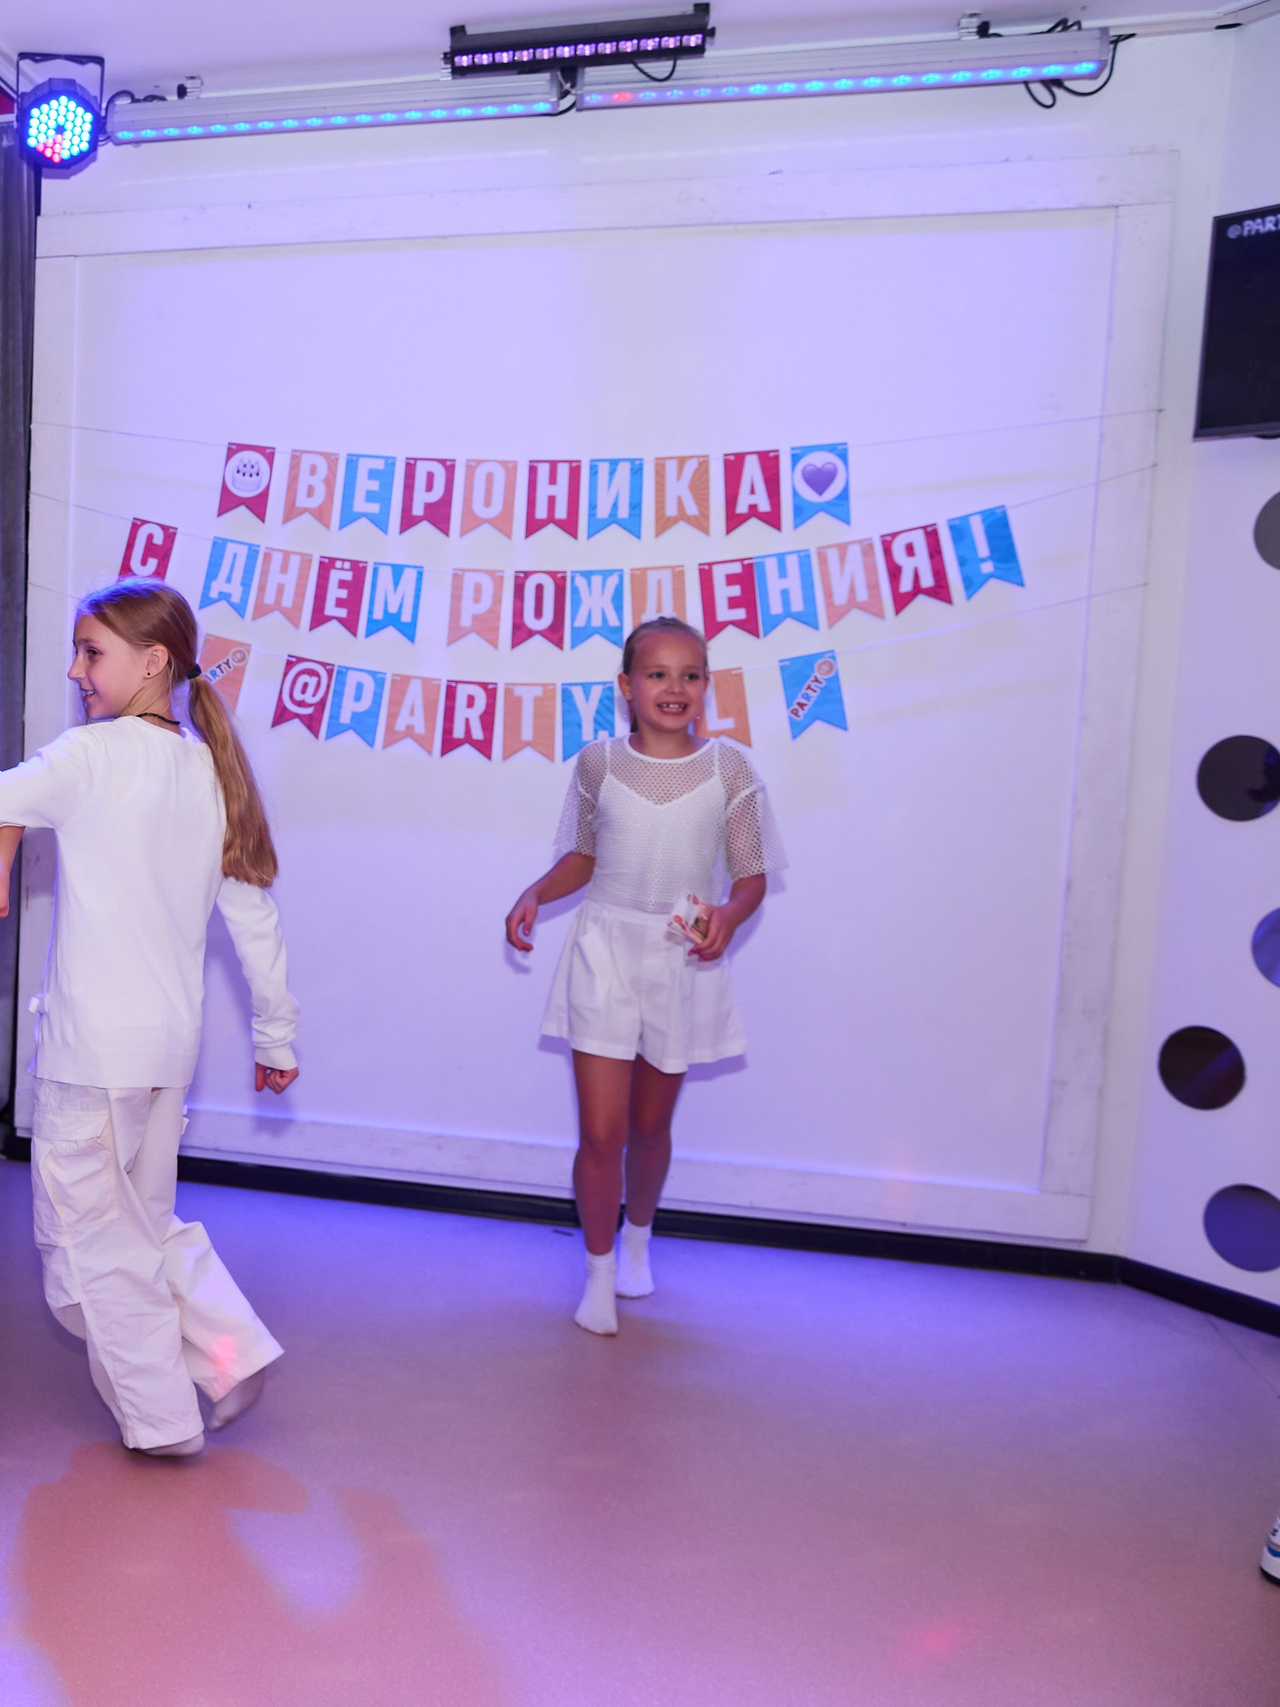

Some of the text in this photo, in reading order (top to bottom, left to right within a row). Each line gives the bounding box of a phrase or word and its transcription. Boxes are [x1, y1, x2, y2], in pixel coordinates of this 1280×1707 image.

[294, 452, 771, 520] ВЕРОНИКА
[130, 514, 995, 632] С ДНЁМ РОЖДЕНИЯ!
[790, 675, 823, 718] PARTY
